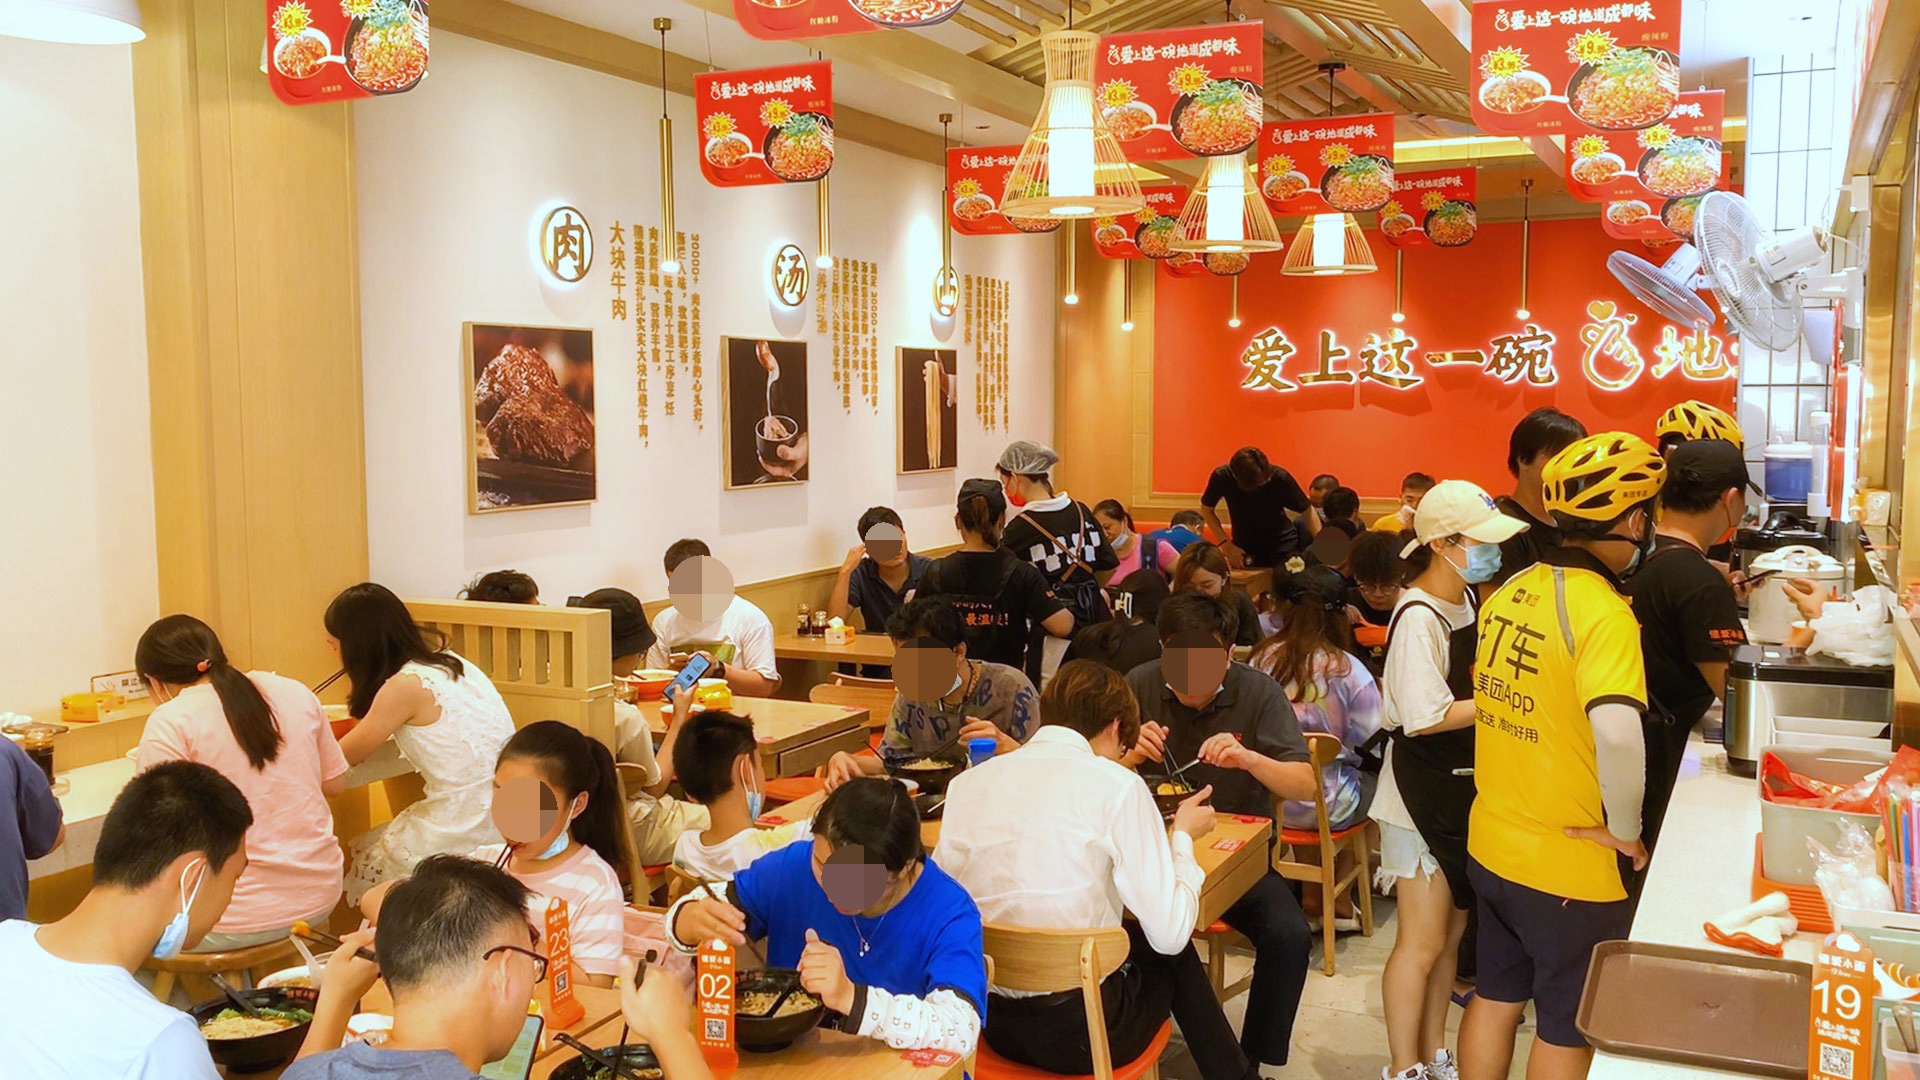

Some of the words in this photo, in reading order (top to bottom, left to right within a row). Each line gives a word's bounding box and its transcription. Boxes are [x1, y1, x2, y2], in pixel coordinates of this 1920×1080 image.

[1511, 2, 1655, 30] 爱上这一碗地道成都味
[1120, 37, 1241, 63] 爱上这一碗地道成都味
[721, 75, 816, 99] 爱上这一碗地道成都味
[553, 213, 585, 276] 肉
[609, 221, 627, 320] 大块牛肉
[1240, 325, 1558, 392] 爱上这一碗
[1652, 325, 1739, 381] 地
[1476, 611, 1546, 680] 打车
[1474, 671, 1535, 717] 美团App
[549, 927, 569, 957] 23
[699, 973, 731, 999] 02
[1813, 980, 1861, 1020] 19
